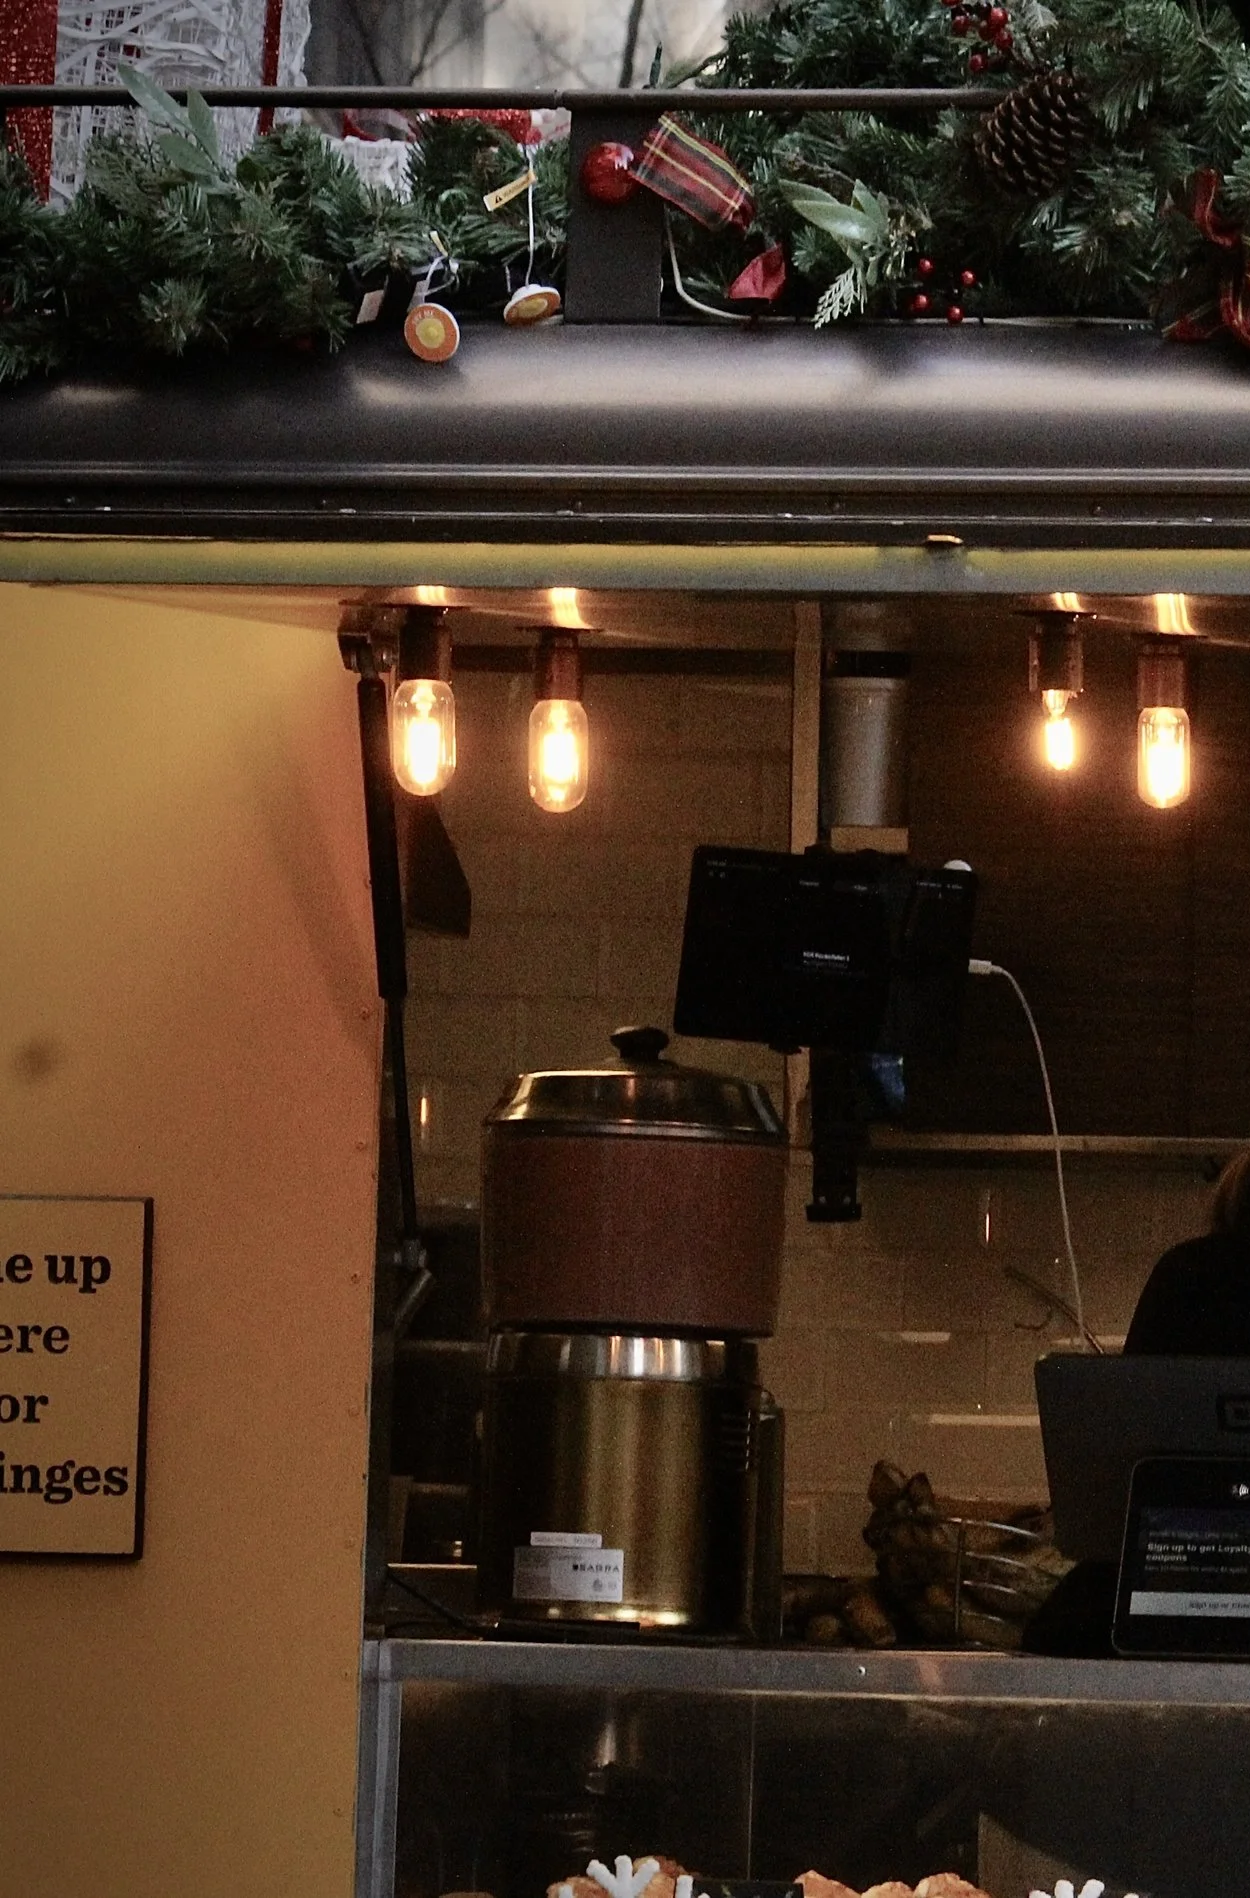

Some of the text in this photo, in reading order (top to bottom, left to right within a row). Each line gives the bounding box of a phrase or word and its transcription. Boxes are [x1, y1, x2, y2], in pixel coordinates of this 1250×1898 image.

[44, 1254, 112, 1294] up
[1147, 1543, 1170, 1553] Sign
[1171, 1544, 1184, 1553] up
[1186, 1544, 1197, 1552] to
[1199, 1544, 1216, 1554] get
